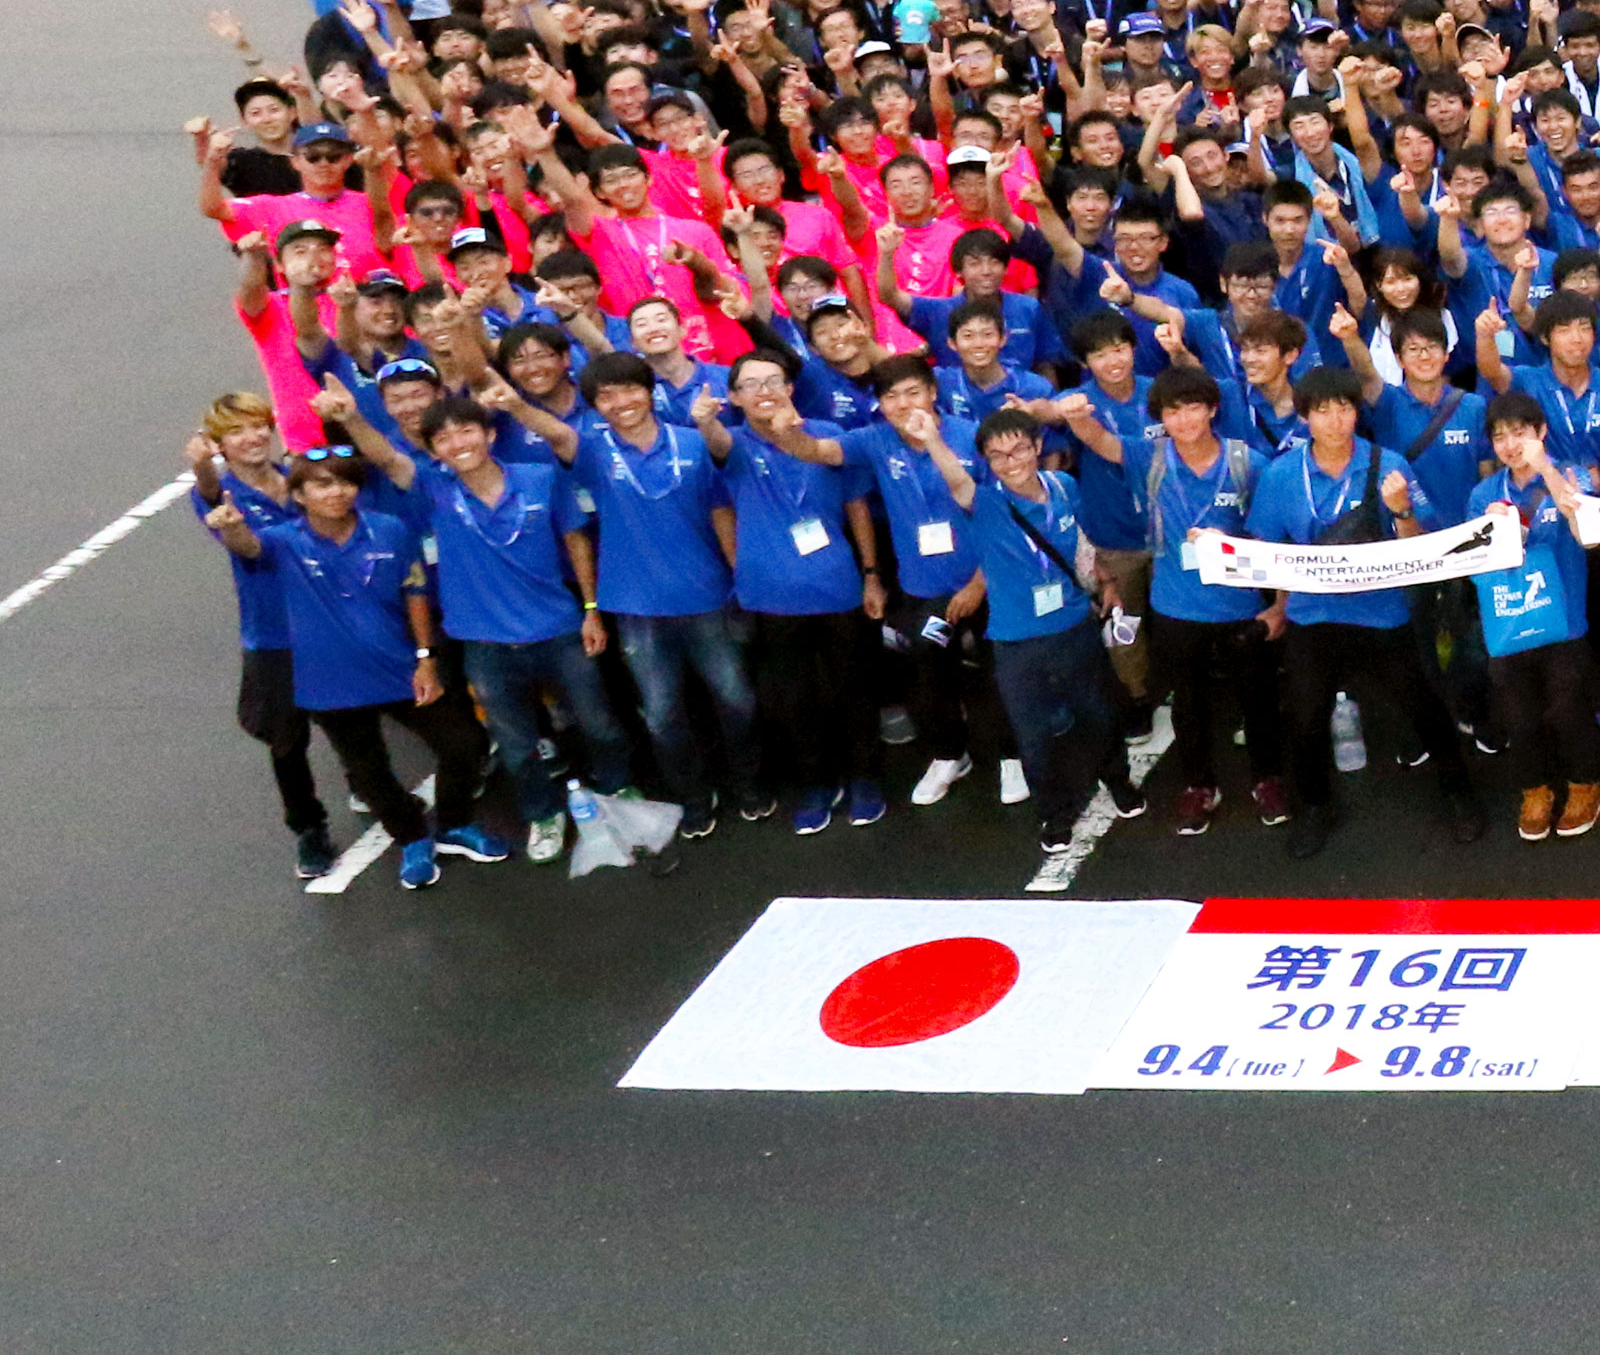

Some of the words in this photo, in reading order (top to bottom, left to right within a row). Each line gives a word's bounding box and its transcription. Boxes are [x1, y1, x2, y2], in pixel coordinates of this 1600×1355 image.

[1274, 553, 1349, 565] FORMULA
[1294, 559, 1423, 576] ENTERTAINMENT
[1247, 945, 1528, 991] 第16回
[1259, 1001, 1467, 1033] 2018年
